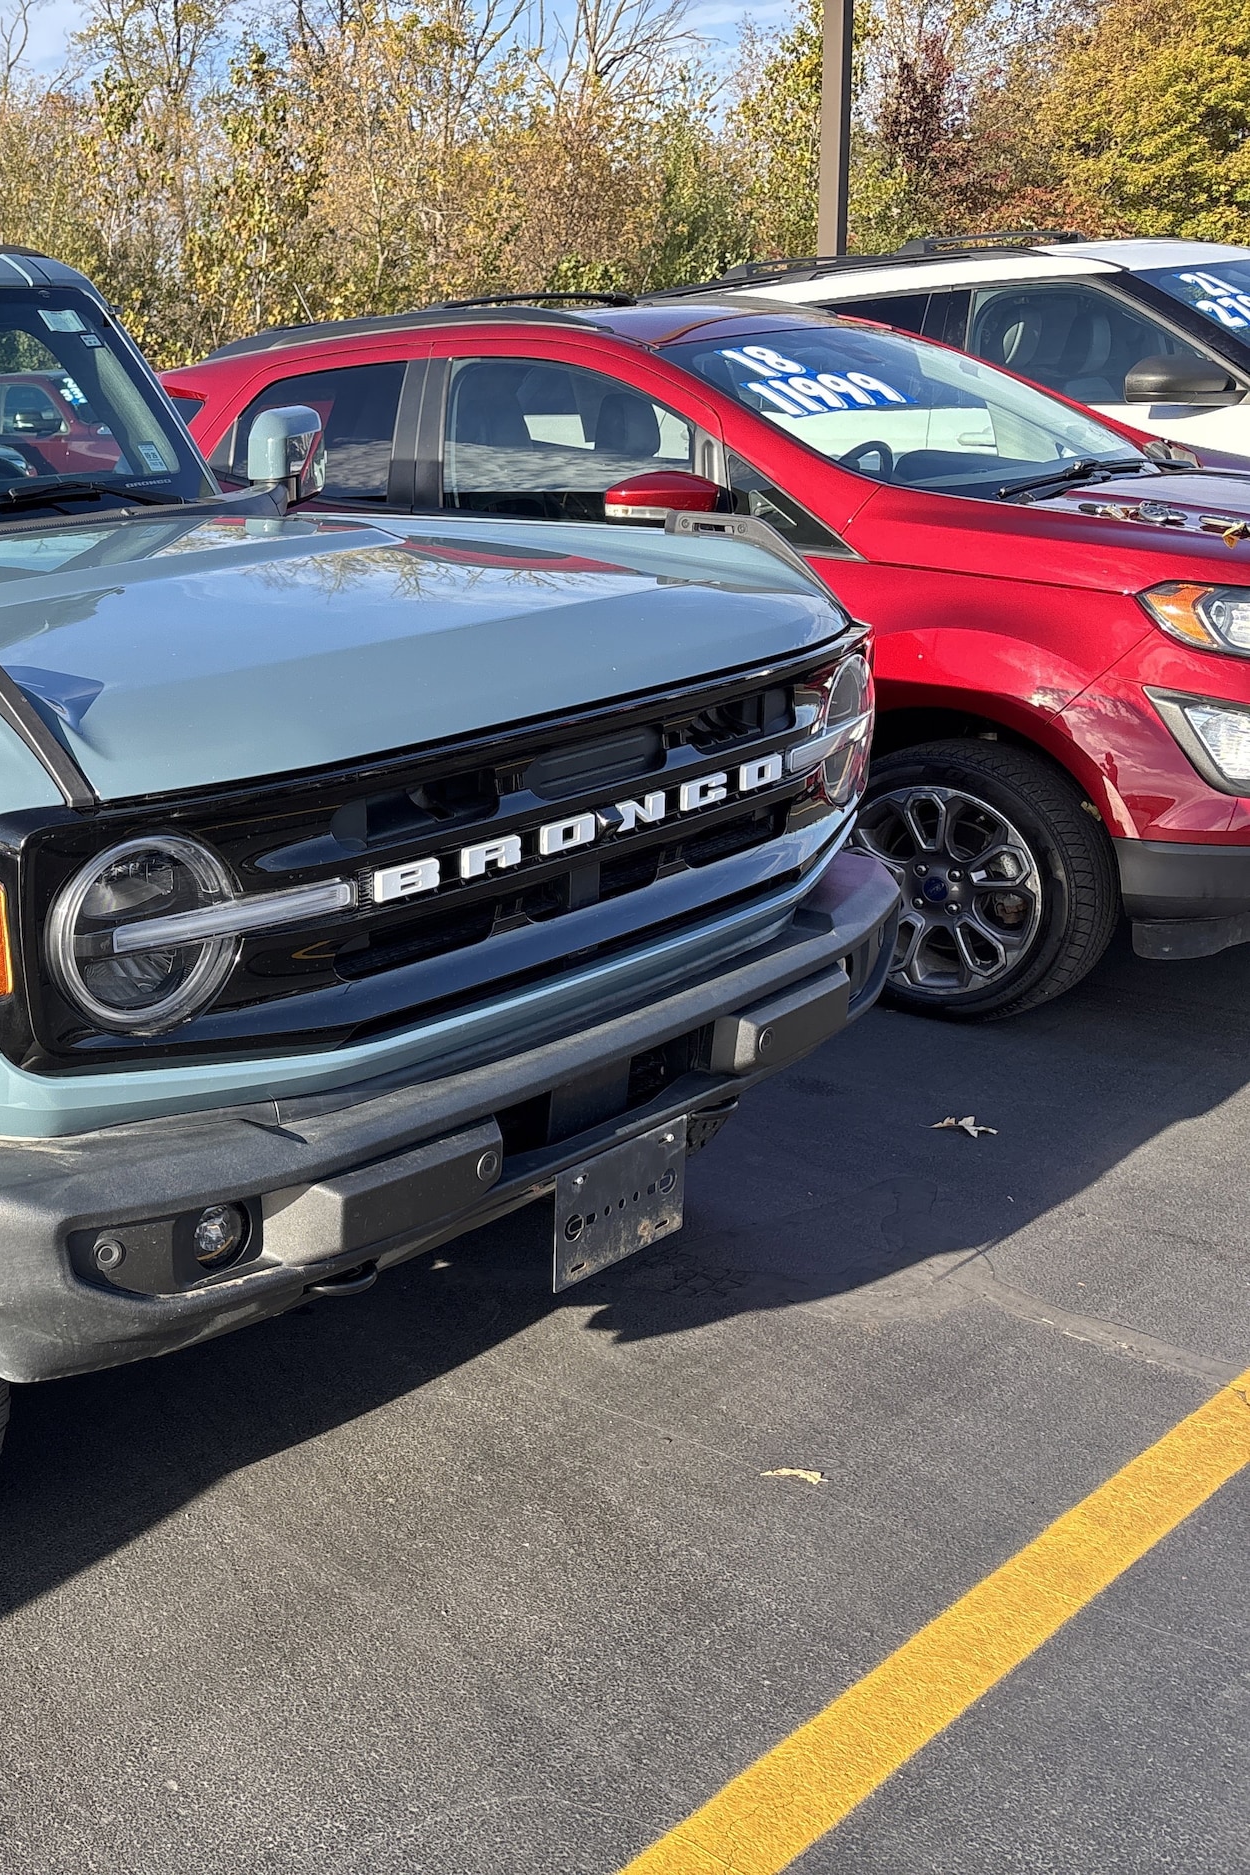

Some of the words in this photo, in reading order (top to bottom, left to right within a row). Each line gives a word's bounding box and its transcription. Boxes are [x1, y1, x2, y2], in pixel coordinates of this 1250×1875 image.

[1179, 271, 1244, 296] 21
[721, 346, 806, 377] 18
[747, 371, 906, 416] 11999
[372, 752, 783, 904] BRONCO
